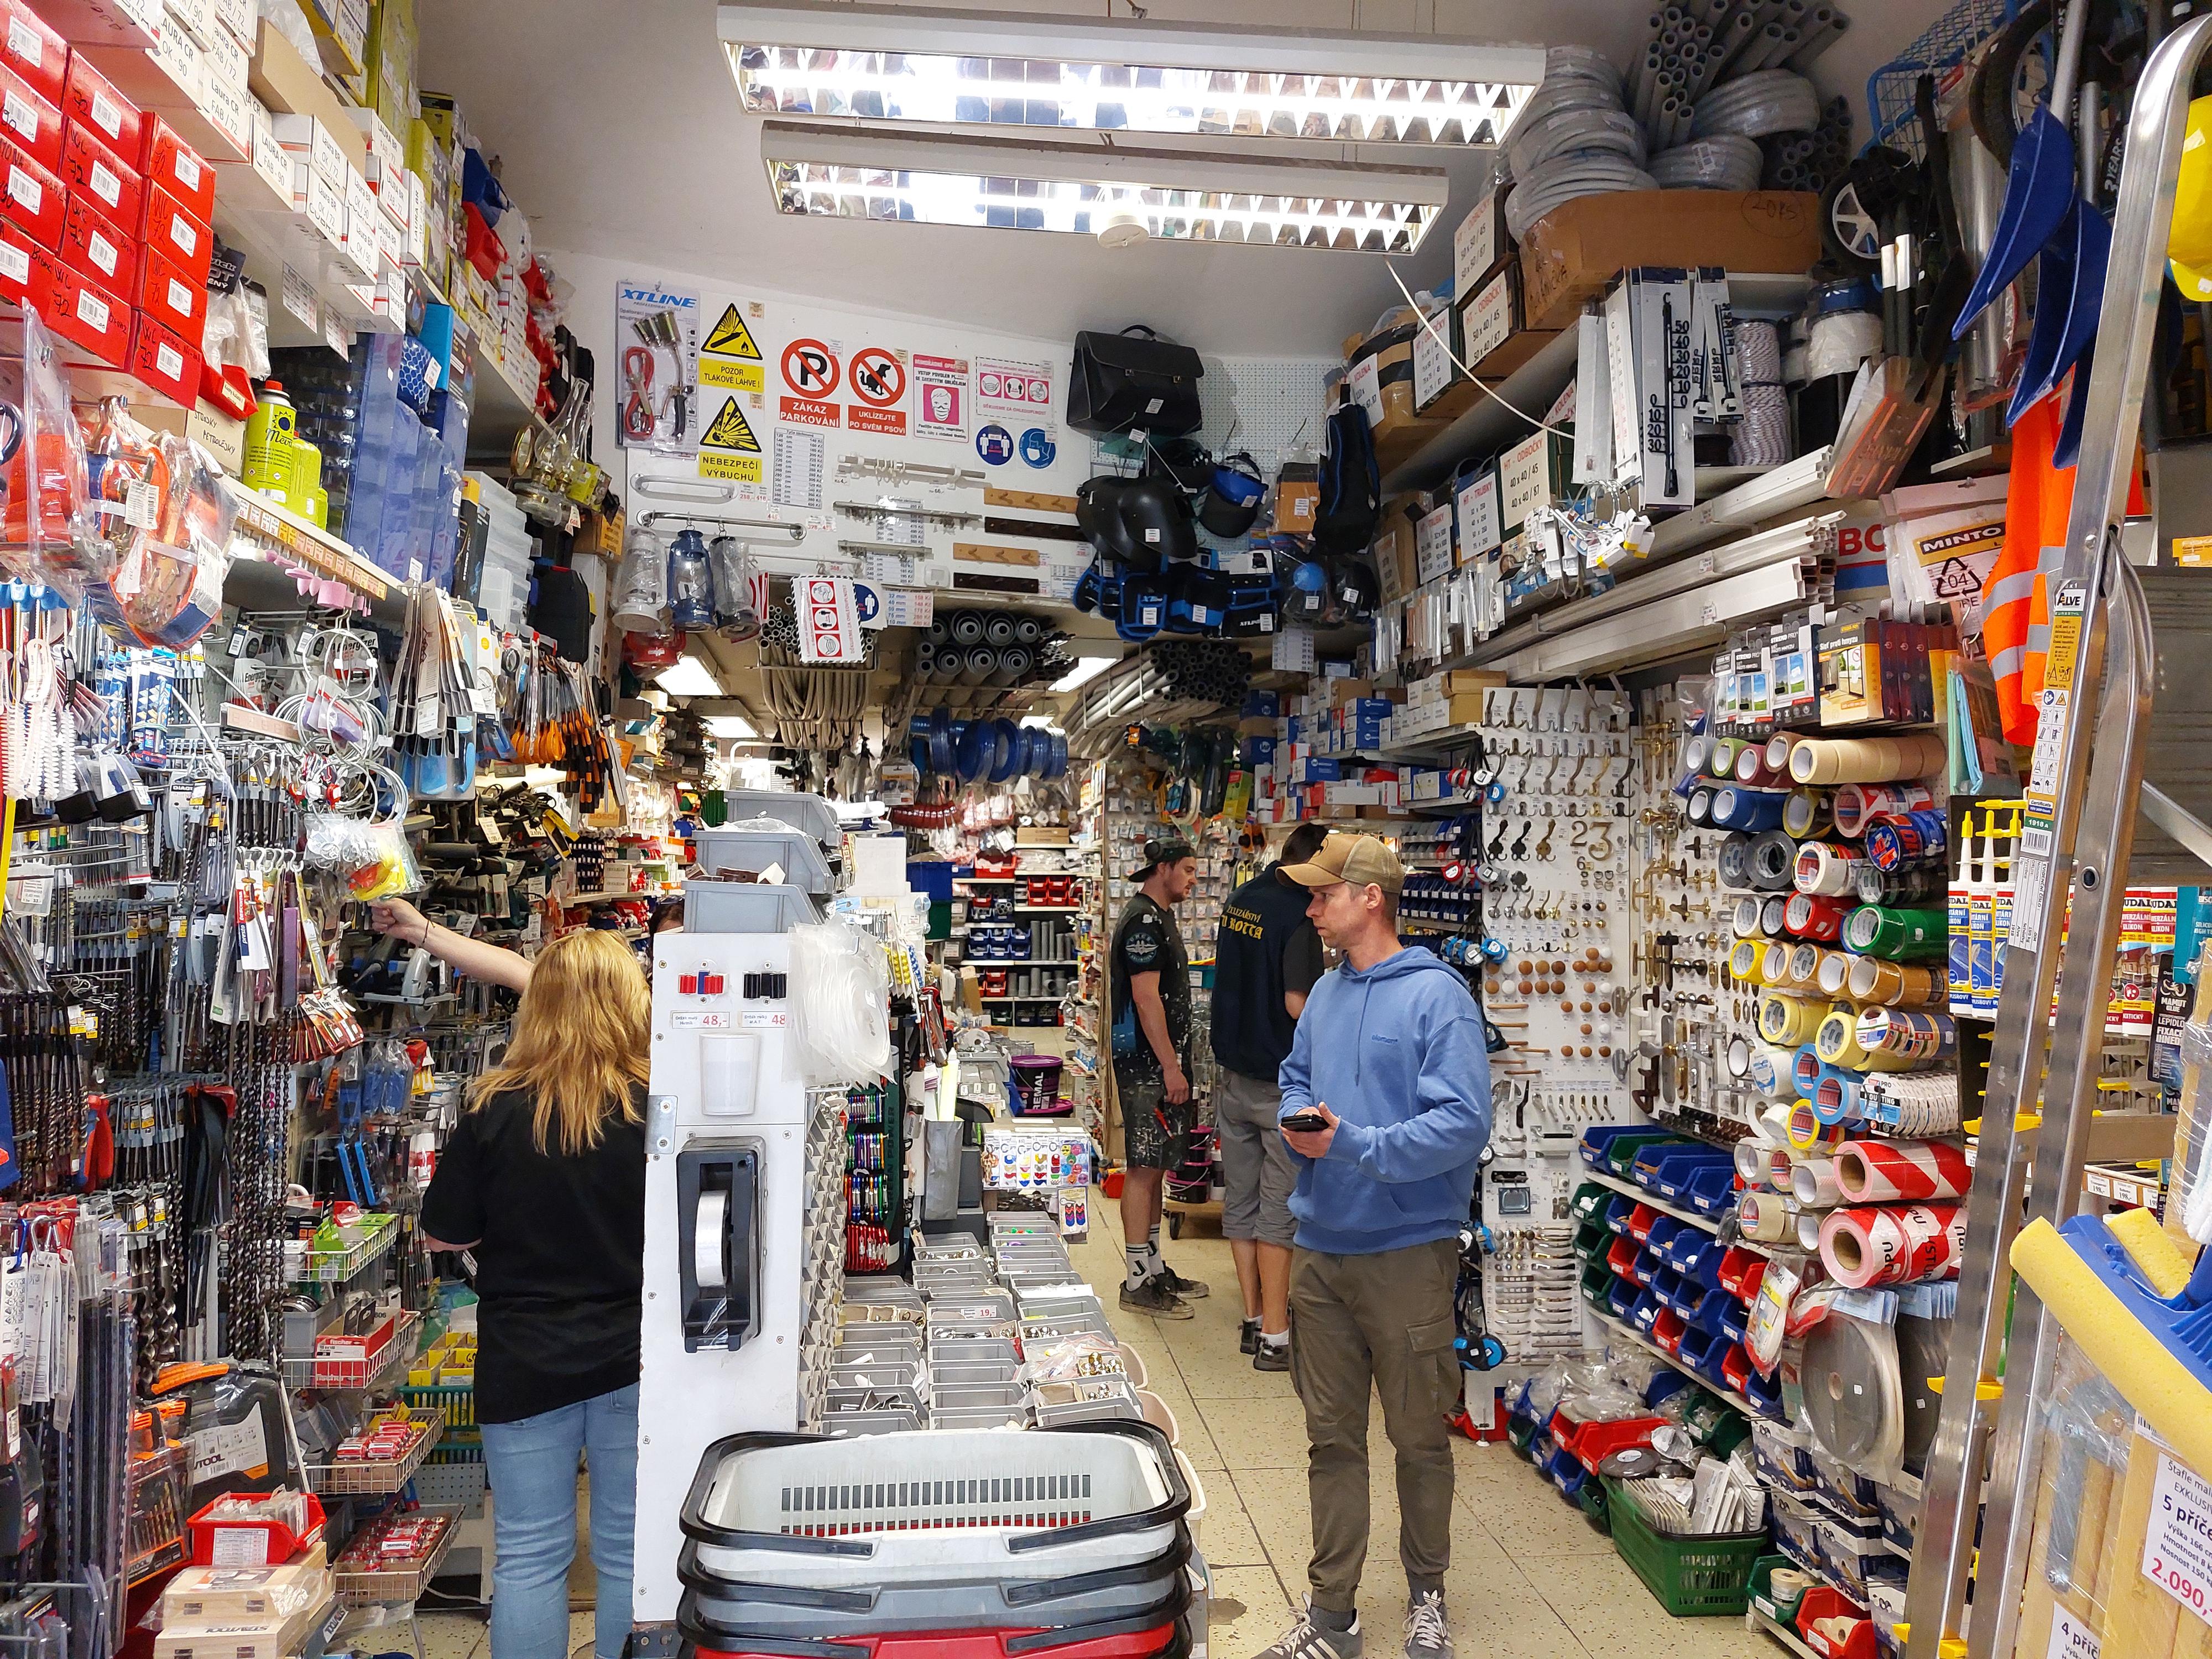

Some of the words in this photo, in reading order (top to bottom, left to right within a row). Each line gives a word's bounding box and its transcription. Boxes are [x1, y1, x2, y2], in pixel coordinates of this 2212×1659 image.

[194, 5, 202, 22] 90
[237, 10, 245, 27] 72
[184, 45, 194, 62] CR
[215, 27, 229, 51] aura
[231, 46, 238, 62] CR
[163, 40, 172, 60] OK
[179, 61, 187, 76] 90
[212, 41, 224, 64] FAB
[229, 65, 237, 81] 72
[211, 78, 229, 105] Laura
[231, 101, 239, 116] CR
[211, 99, 223, 120] FAB
[230, 119, 238, 135] 72
[253, 101, 260, 116] CR
[378, 124, 392, 144] LAURA
[262, 132, 279, 160] LAURA
[280, 156, 287, 171] CR
[322, 133, 334, 155] Laura
[334, 150, 341, 164] BR
[263, 156, 274, 173] FAB
[278, 171, 284, 186] 90
[322, 153, 328, 165] OK
[332, 166, 338, 179] 72
[354, 176, 365, 196] Laura
[366, 191, 371, 205] BR
[387, 174, 399, 194] LAURA
[318, 182, 330, 204] Laura
[331, 197, 336, 212] BR
[318, 202, 325, 215] OK
[329, 213, 335, 227] 72
[354, 195, 361, 208] OK
[363, 206, 369, 220] 90
[356, 222, 367, 242] Laura
[367, 236, 373, 249] BR
[378, 220, 391, 239] LAURA
[356, 242, 363, 254] OK
[366, 253, 372, 264] 90
[53, 290, 72, 317] 72
[620, 289, 697, 308] XTLINE
[1663, 293, 1671, 305] C
[1473, 329, 1479, 342] 50
[1483, 319, 1489, 331] 40
[1493, 309, 1500, 321] 45
[1675, 320, 1690, 331] 50
[1676, 336, 1690, 347] 40
[1474, 349, 1480, 362] 50
[1484, 340, 1490, 351] 40
[1676, 350, 1690, 362] 30
[704, 373, 734, 384] TLAKOVÉ
[735, 377, 756, 387] LAHVE
[721, 366, 744, 376] POZOR
[1676, 366, 1691, 377] 20
[1678, 380, 1691, 392] 10
[792, 401, 827, 414] ZÁKAZ
[1554, 387, 1574, 415] KOLENA
[1650, 394, 1657, 405] 0
[1681, 395, 1687, 405] 0
[780, 412, 839, 427] PARKOVÁNÍ
[858, 410, 896, 422] UKLÍZEJTE
[1648, 409, 1661, 421] 10
[862, 420, 882, 431] SVÉM
[884, 426, 906, 434] PSOVI
[1647, 424, 1662, 436] 20
[1647, 439, 1662, 451] 30
[702, 455, 758, 469] NEBEZPEČÍ
[1504, 458, 1511, 471] HT
[1517, 438, 1543, 462] ODBOČKY
[707, 468, 754, 482] VÝBUCHU
[1510, 477, 1516, 488] 40
[1521, 470, 1527, 483] 40
[1532, 463, 1538, 474] 45
[1511, 497, 1517, 509] 40
[1522, 489, 1528, 502] 40
[1533, 484, 1540, 497] 87
[1923, 527, 2002, 553] MINTO
[1948, 573, 1969, 588] 04
[2057, 592, 2081, 607] ALVE
[1830, 639, 1841, 649] proti
[1841, 636, 1858, 646] hmyzu
[244, 669, 266, 683] Energizer
[2030, 800, 2052, 808] Certificate
[2038, 863, 2047, 892] EVIDENČNÍ
[2161, 997, 2187, 1008] MAMUT
[702, 1015, 727, 1027] 48,-
[2093, 1186, 2106, 1195] 198,-
[2119, 1192, 2133, 1202] 198,-
[2168, 1459, 2192, 1483] Štafle
[2163, 1494, 2172, 1511] 5
[2176, 1506, 2212, 1541] příče
[2167, 1521, 2188, 1541] Výška
[2190, 1537, 2204, 1551] 166
[2163, 1532, 2199, 1563] Hmotnost
[2201, 1558, 2206, 1567] 8
[2160, 1543, 2190, 1570] Nosnost
[2192, 1566, 2205, 1580] 150
[2061, 1622, 2069, 1636] 4
